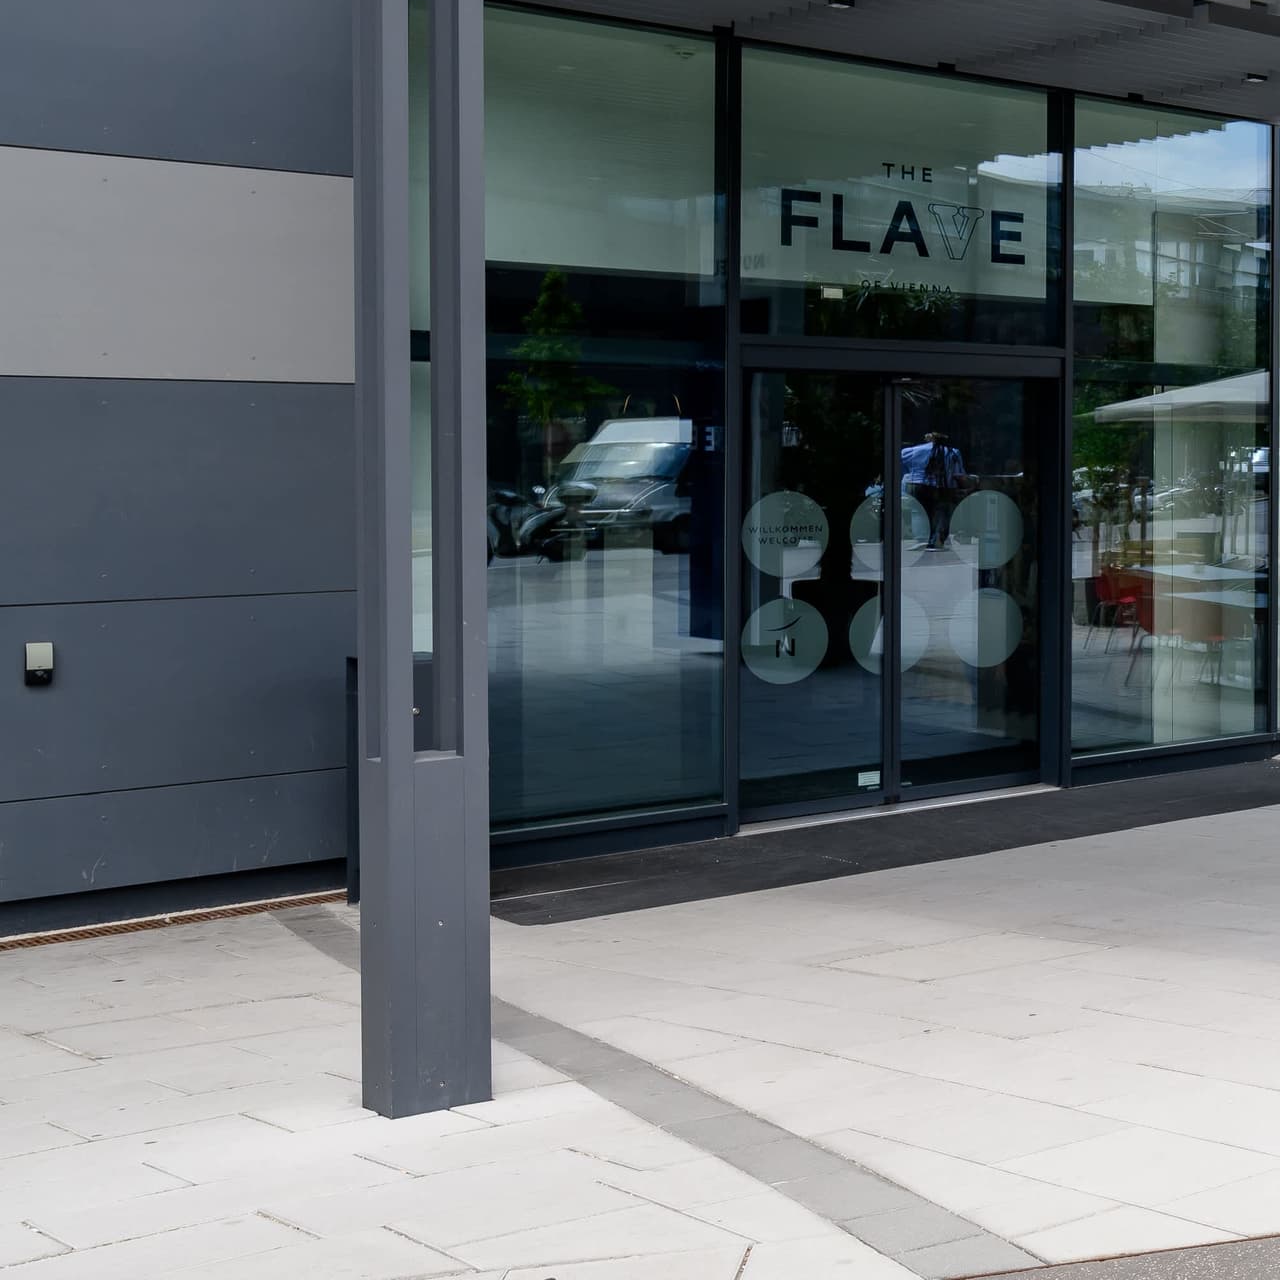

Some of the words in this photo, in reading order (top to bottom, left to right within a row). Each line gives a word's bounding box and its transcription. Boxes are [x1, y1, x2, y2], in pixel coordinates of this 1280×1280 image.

[882, 162, 933, 183] THE
[780, 188, 1026, 265] FLAVE
[861, 280, 881, 289] OF
[890, 281, 952, 293] VIENNA
[749, 524, 823, 535] WILLKOMMEN
[775, 638, 796, 658] N
